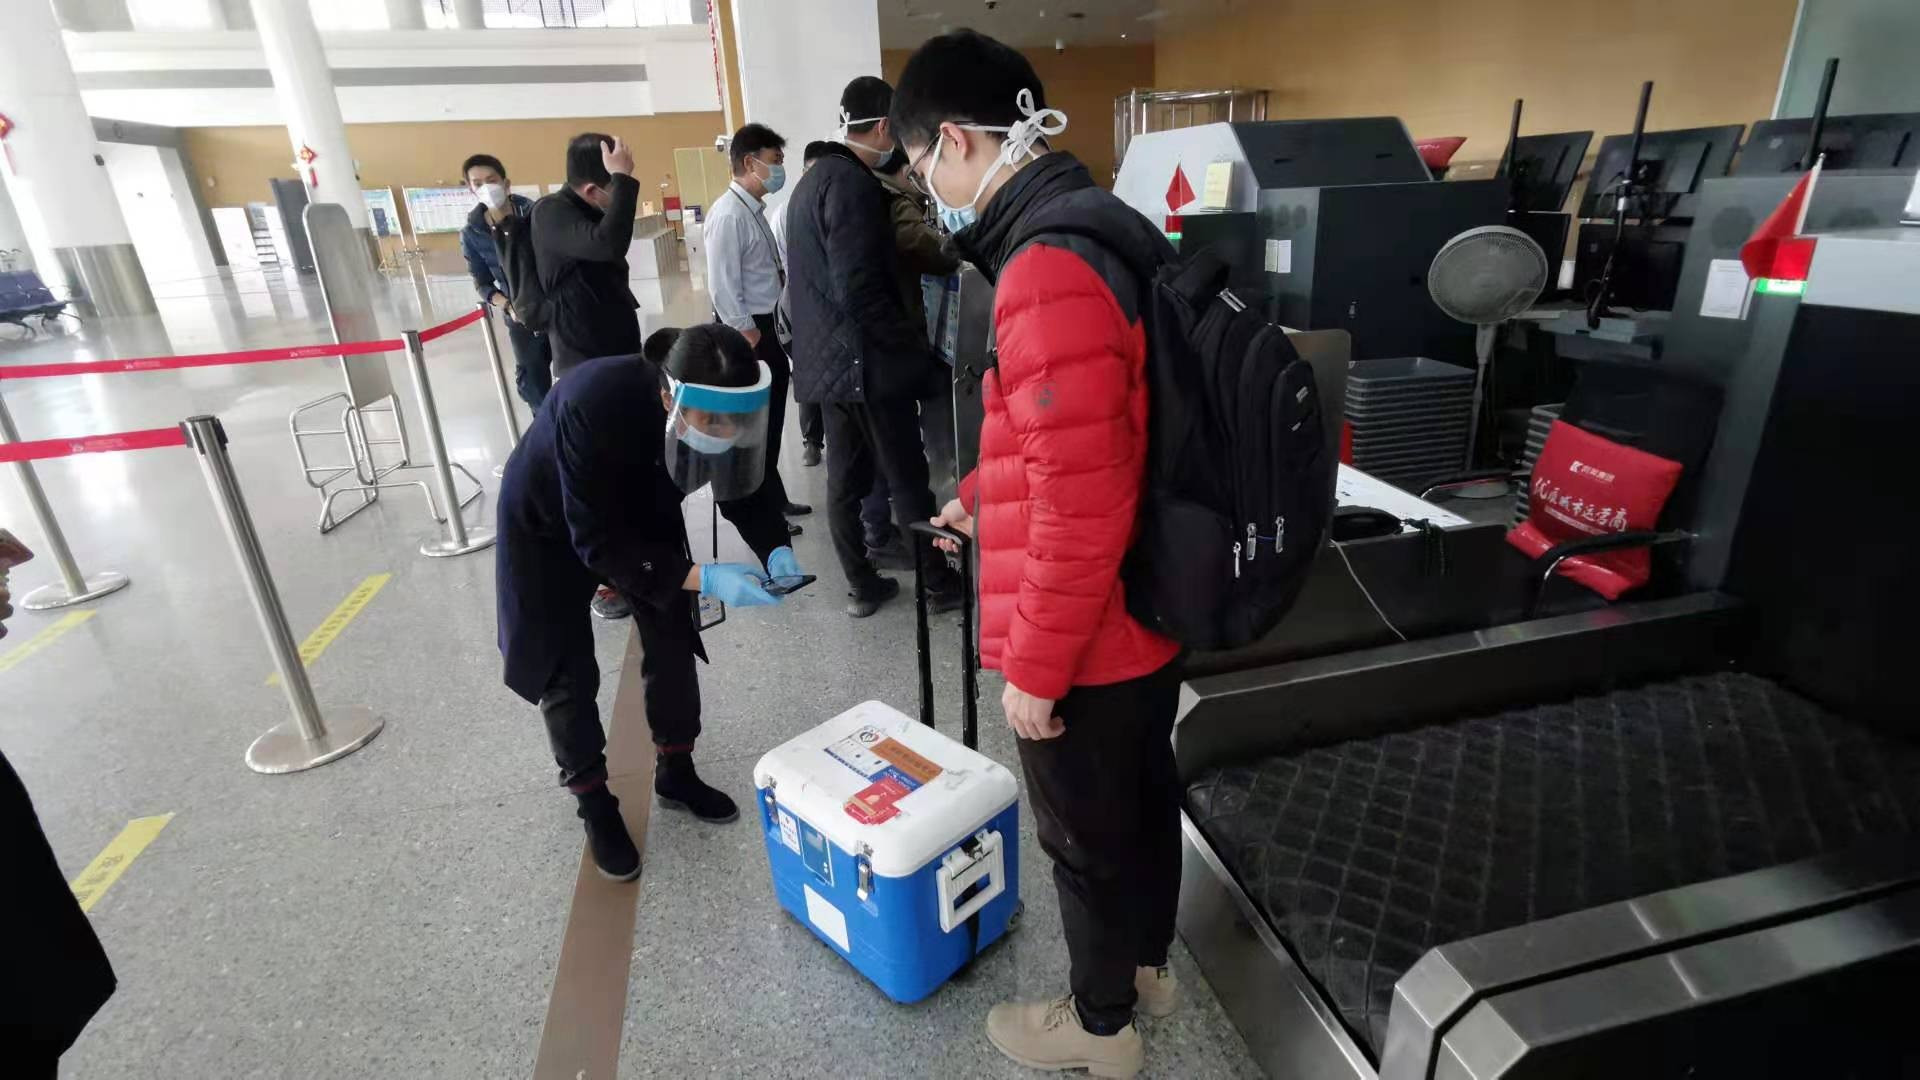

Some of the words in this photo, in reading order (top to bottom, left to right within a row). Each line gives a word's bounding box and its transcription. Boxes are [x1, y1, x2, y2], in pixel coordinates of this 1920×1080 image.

[1533, 477, 1628, 532] 优质城市运营商
